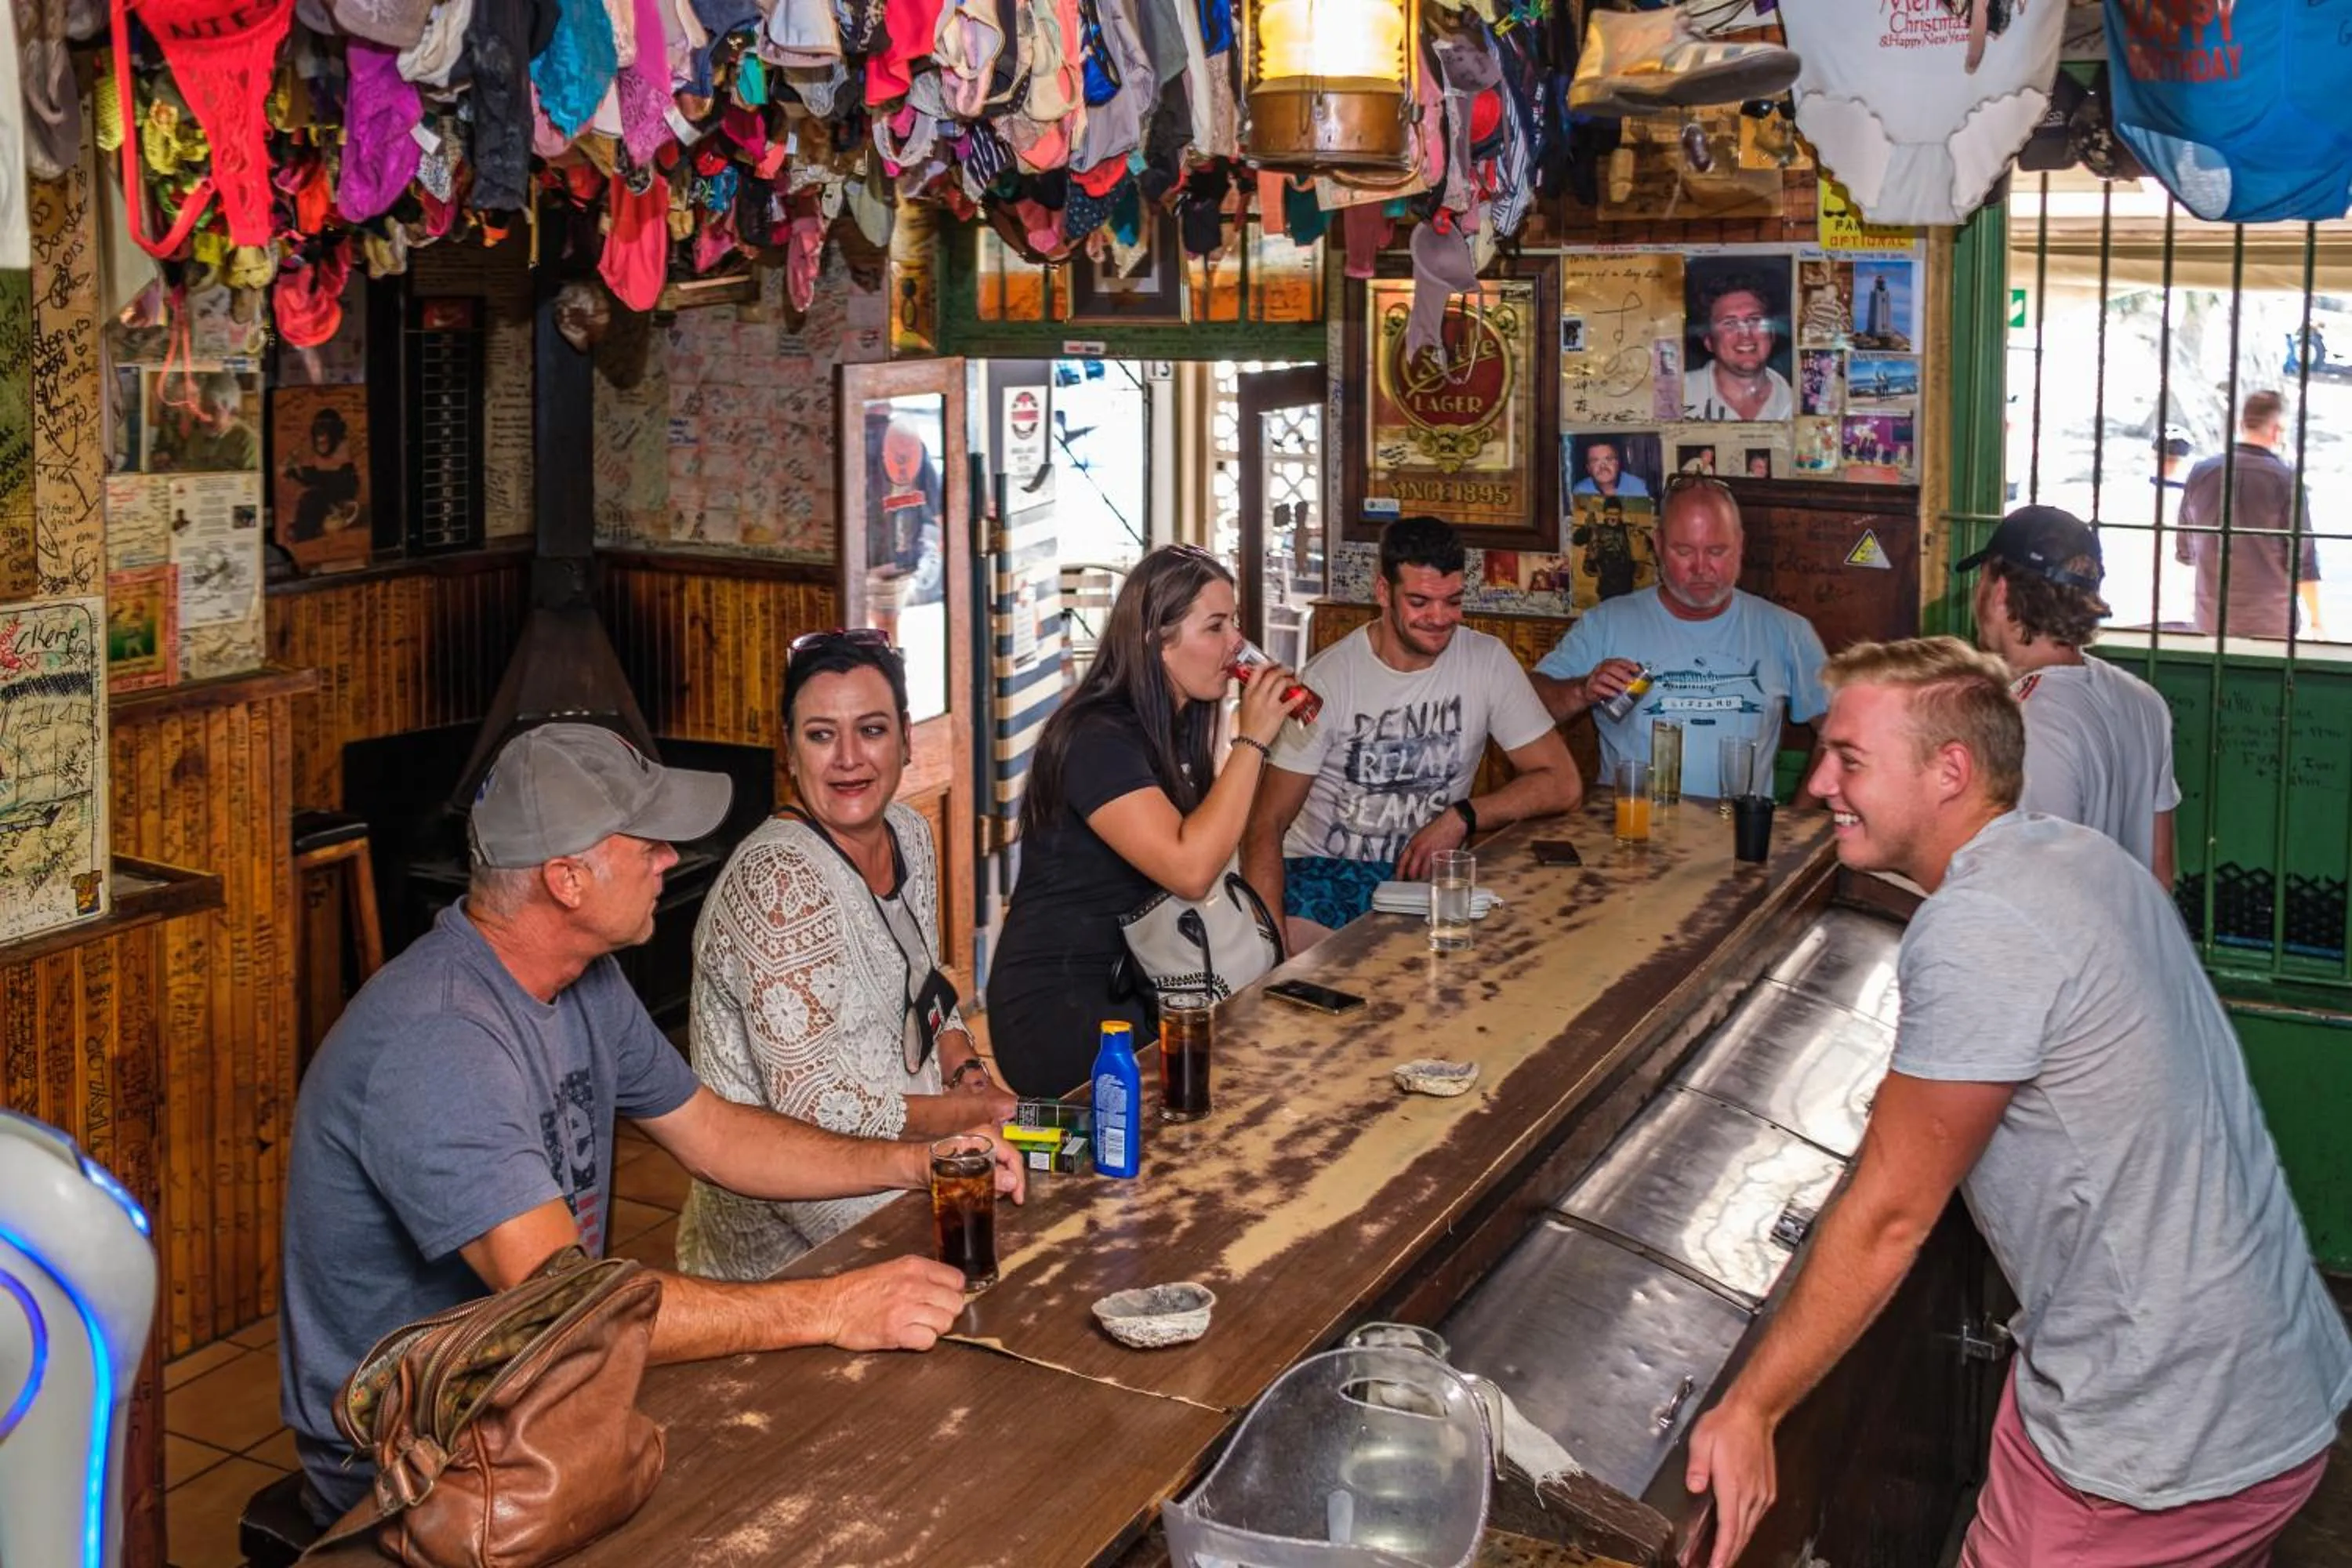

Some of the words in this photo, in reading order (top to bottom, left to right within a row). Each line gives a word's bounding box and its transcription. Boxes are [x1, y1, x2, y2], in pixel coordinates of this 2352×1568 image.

[1829, 236, 1908, 248] OPTIONAL
[1414, 395, 1483, 421] LAGER
[1390, 480, 1447, 503] SINCE
[1455, 481, 1512, 506] 1895
[1348, 695, 1462, 742] DENIM
[1358, 743, 1456, 784] RELAY
[1338, 789, 1450, 830] JEANS
